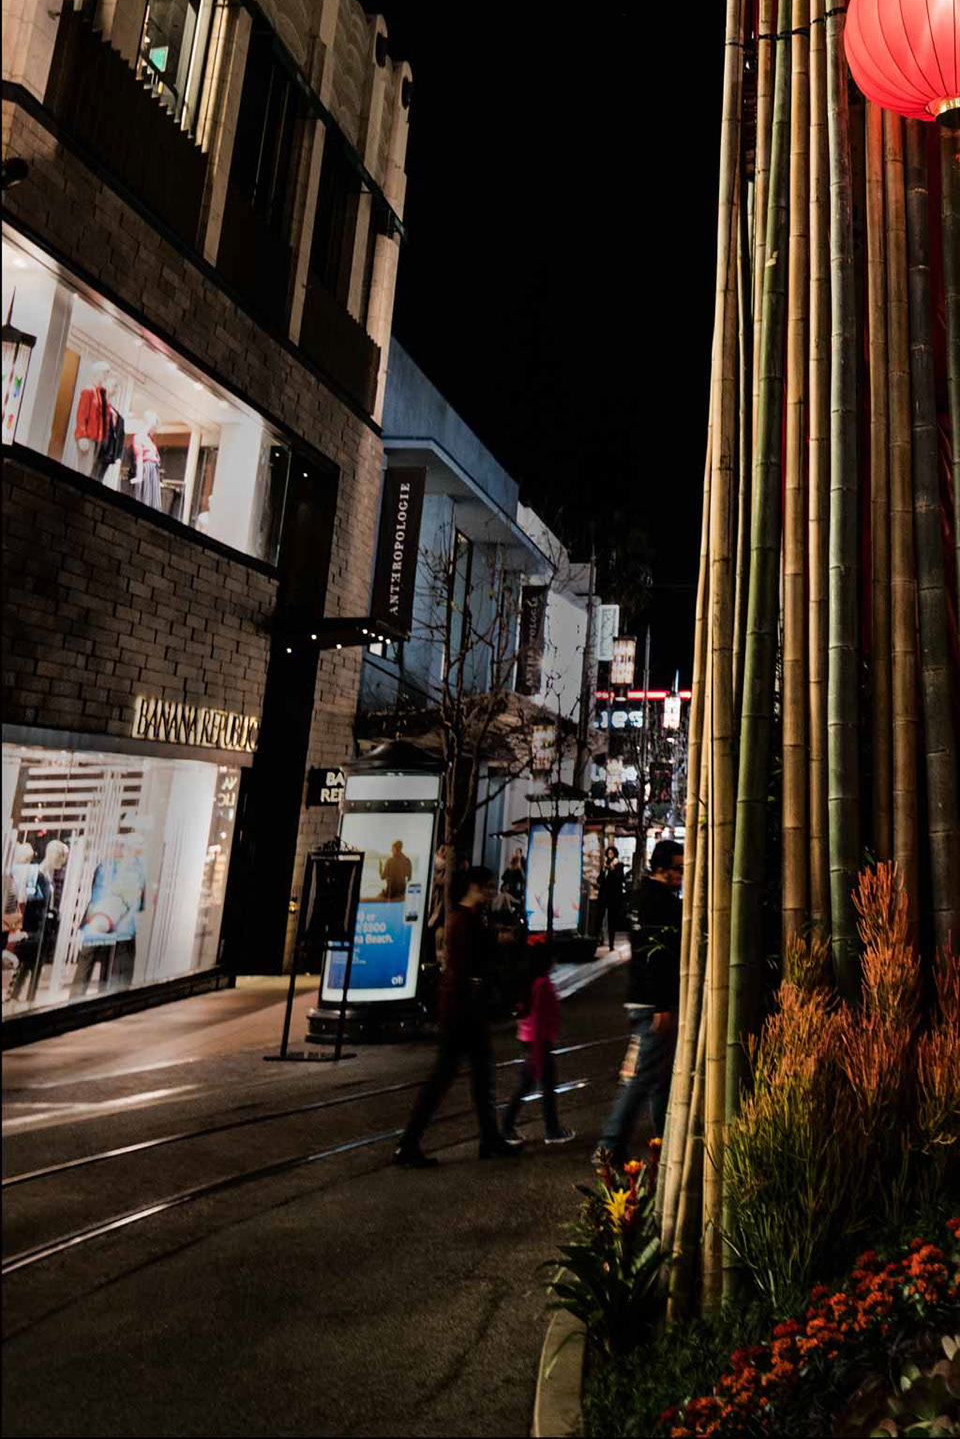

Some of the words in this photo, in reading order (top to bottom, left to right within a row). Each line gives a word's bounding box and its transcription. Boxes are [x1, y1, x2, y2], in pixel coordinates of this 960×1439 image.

[388, 481, 412, 616] ANTHROPOLOGIE
[132, 696, 198, 745] BANANA
[199, 707, 260, 752] REPUBLIC
